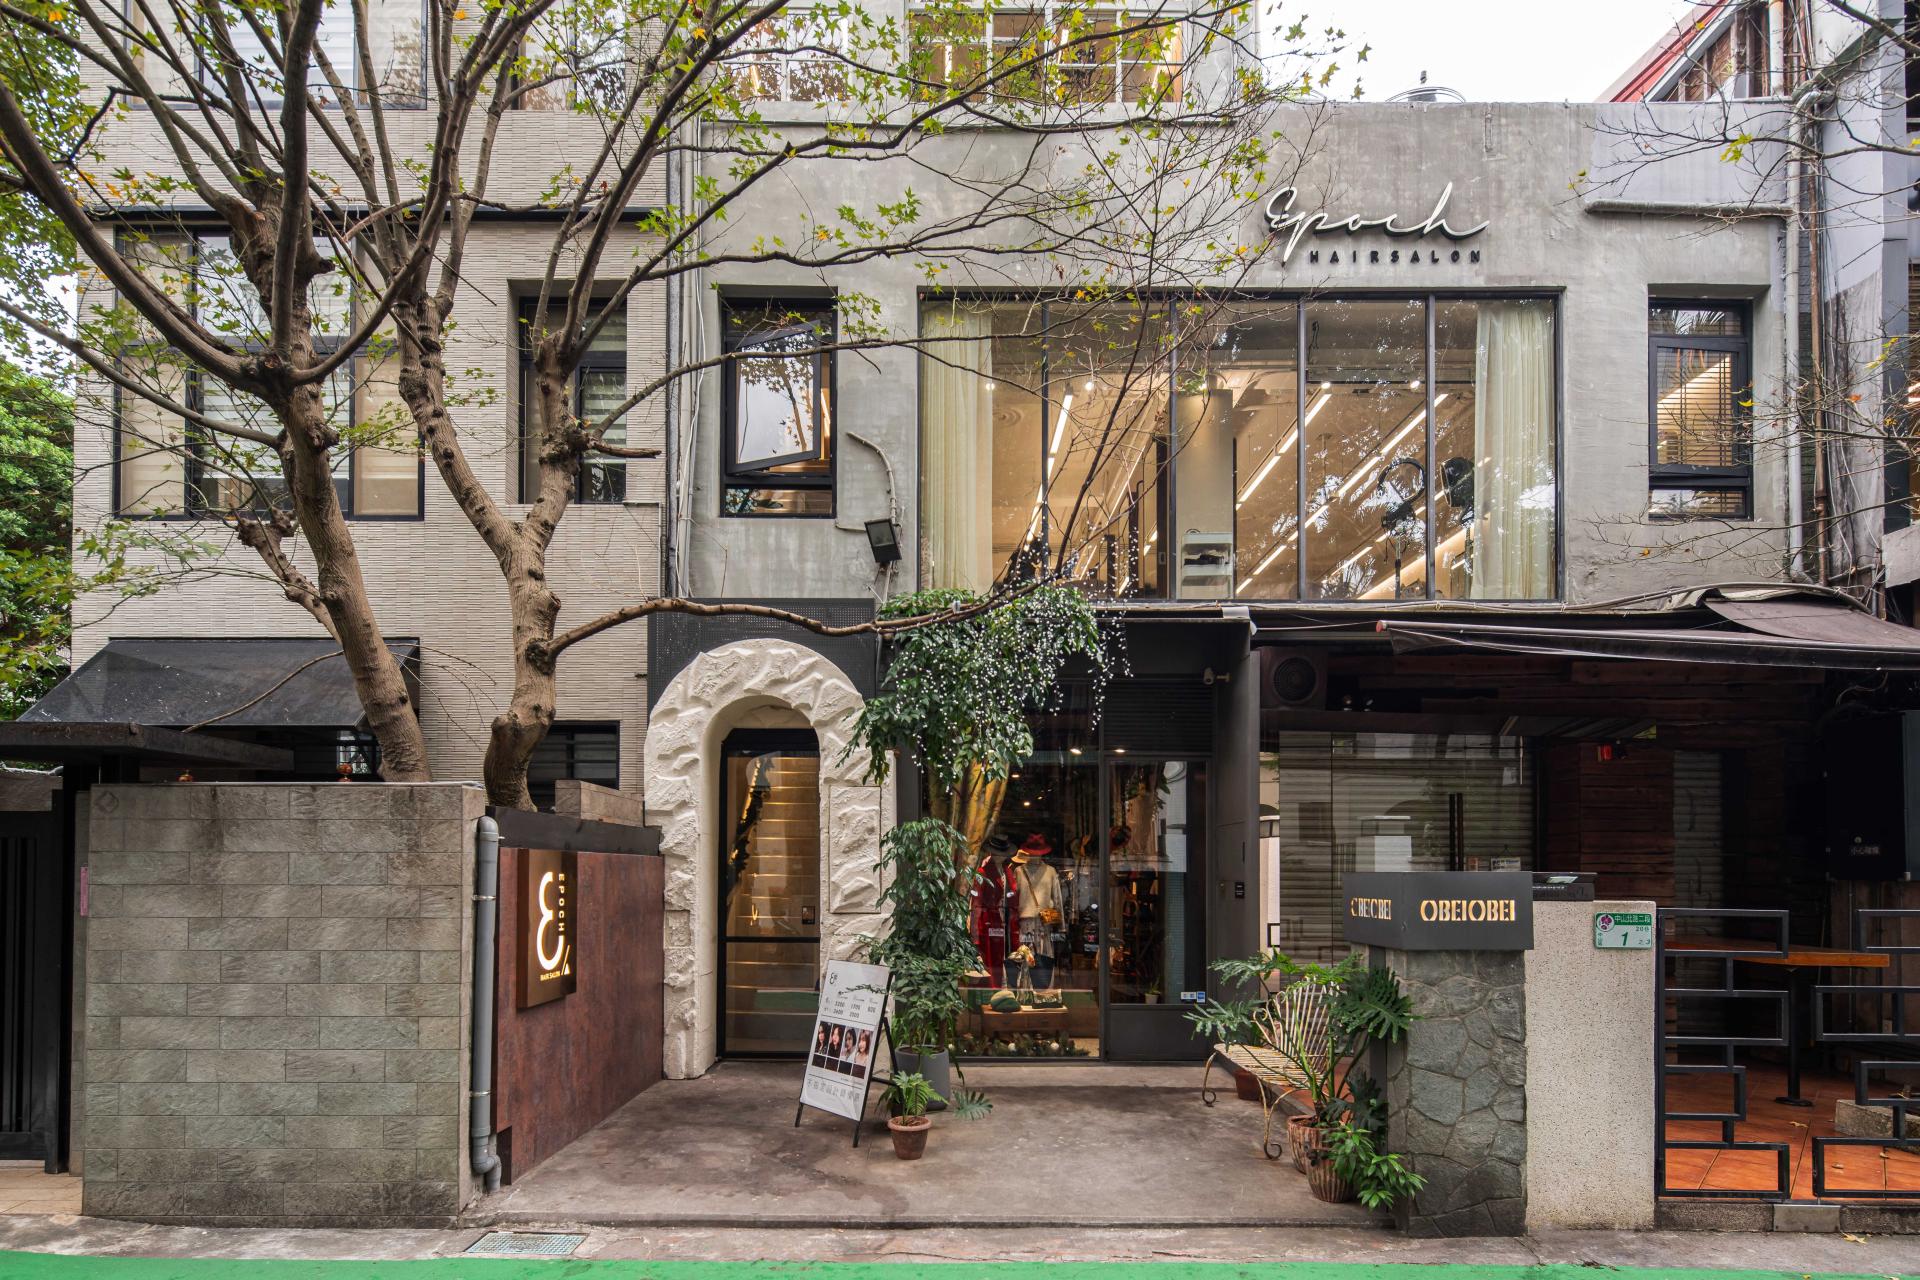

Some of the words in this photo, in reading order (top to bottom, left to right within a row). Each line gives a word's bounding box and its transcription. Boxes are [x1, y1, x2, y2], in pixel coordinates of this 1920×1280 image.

[1264, 182, 1490, 267] Epoch
[1420, 899, 1516, 922] OBEIOBEI
[1614, 914, 1651, 923] 中山北路二段
[1621, 931, 1629, 947] 1
